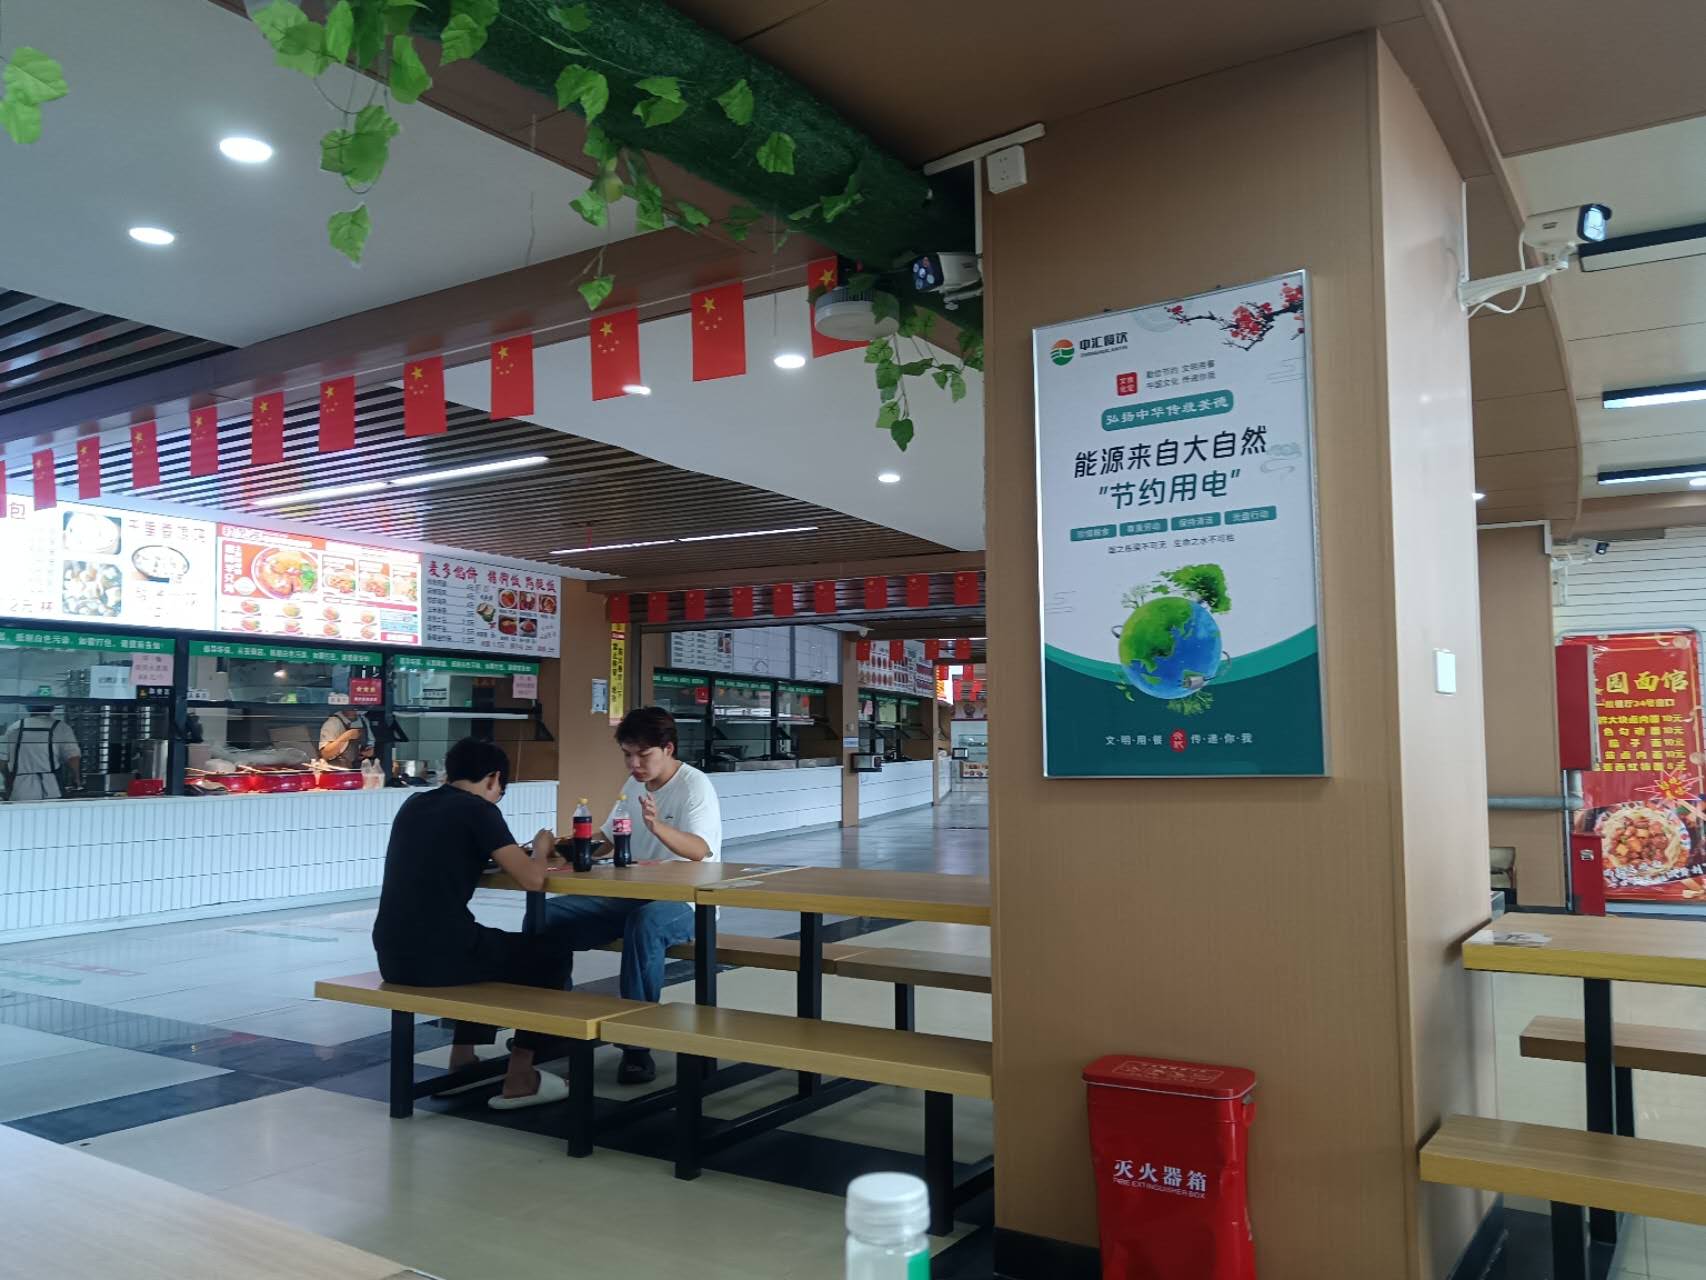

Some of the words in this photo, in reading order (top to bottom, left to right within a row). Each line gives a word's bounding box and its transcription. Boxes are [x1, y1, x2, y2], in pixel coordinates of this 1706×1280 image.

[1105, 396, 1229, 426] 弘扬中华传统美德
[1074, 425, 1267, 478] 能源来自大自然
[1113, 1159, 1208, 1192] 灭火器箱
